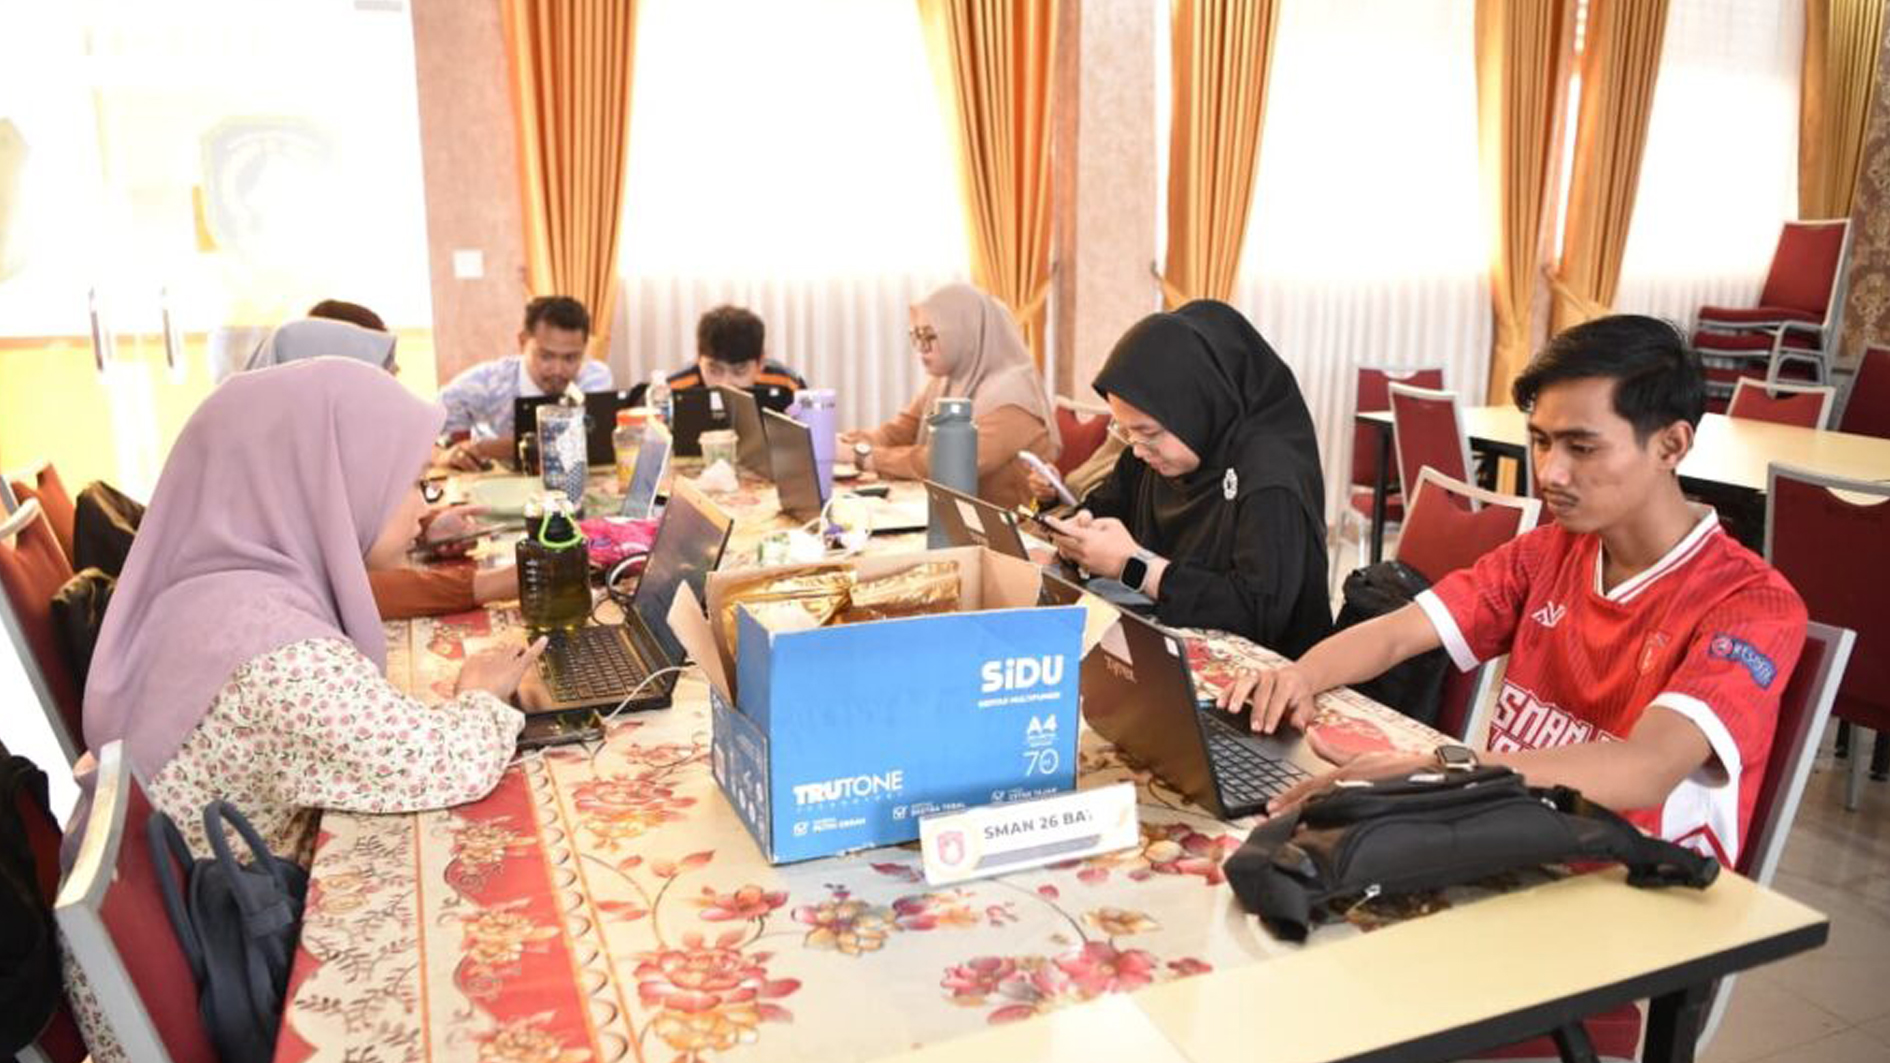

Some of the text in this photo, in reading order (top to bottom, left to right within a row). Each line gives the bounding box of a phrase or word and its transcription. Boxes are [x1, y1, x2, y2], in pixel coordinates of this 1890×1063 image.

[1026, 713, 1058, 735] A4
[1022, 748, 1059, 776] 70
[792, 769, 904, 805] TRUTONE
[984, 821, 1035, 840] SMAN
[1039, 814, 1060, 831] 26
